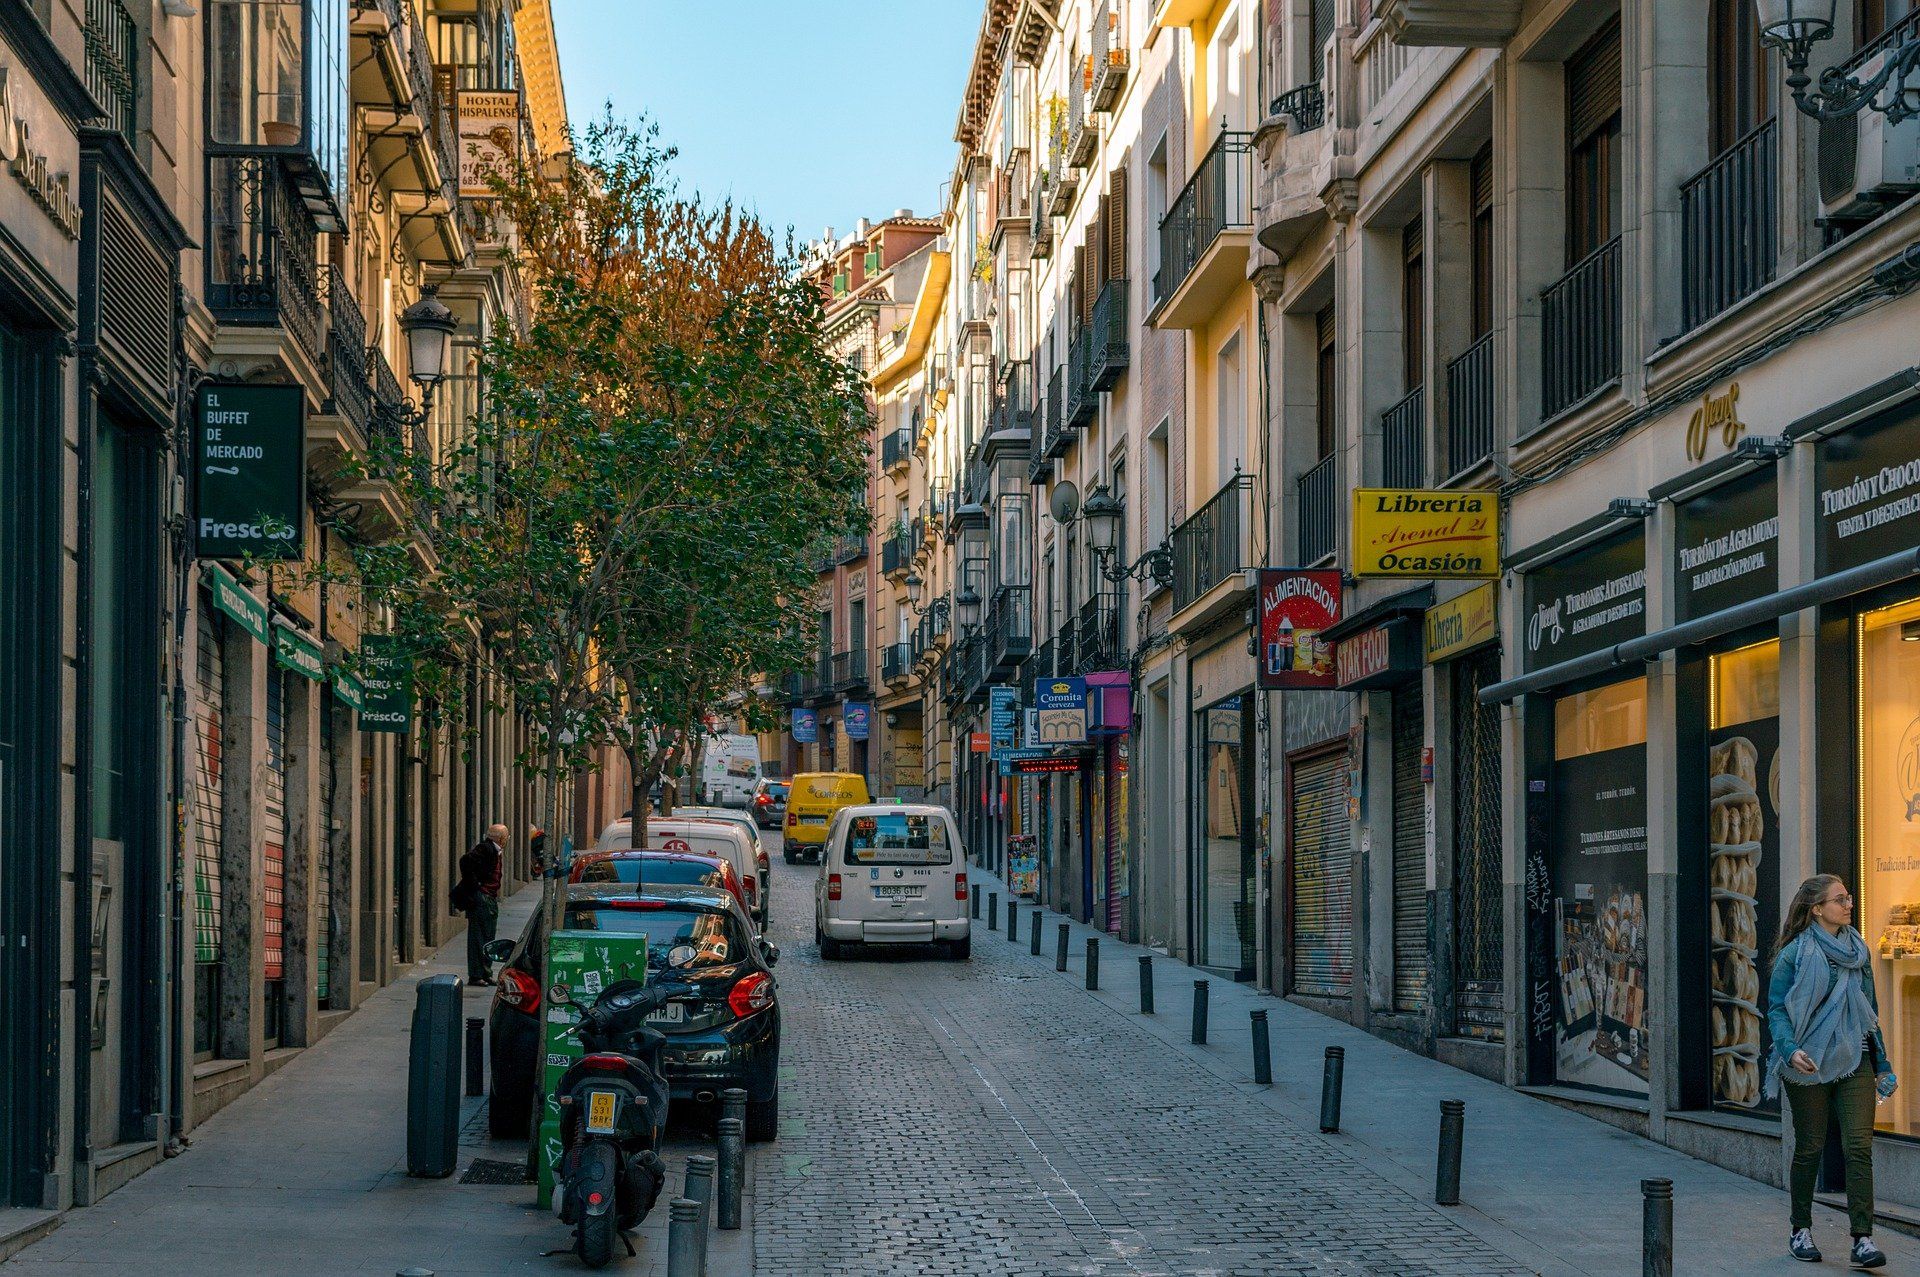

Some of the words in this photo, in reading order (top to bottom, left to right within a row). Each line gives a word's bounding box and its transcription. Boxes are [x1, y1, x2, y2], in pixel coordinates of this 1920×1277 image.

[466, 97, 511, 106] HOSTAL
[460, 108, 517, 118] HISPALENSE
[20, 120, 83, 240] Santander
[207, 394, 220, 407] EL
[207, 411, 249, 425] BUFFET
[207, 428, 221, 441] DE
[207, 445, 263, 459] MERCADO
[1376, 494, 1482, 513] Librería
[1372, 517, 1461, 545] Arenal
[1378, 553, 1482, 571] Ocasión
[1264, 576, 1337, 618] ALIMENTACION
[1428, 603, 1463, 652] Librería
[1337, 635, 1360, 682] STAR
[1362, 628, 1389, 676] FOOD
[364, 680, 402, 690] MERCAO
[1040, 693, 1082, 703] Coronita
[815, 789, 853, 799] CORREOS
[669, 842, 683, 850] 15
[1876, 854, 1906, 873] Tradición
